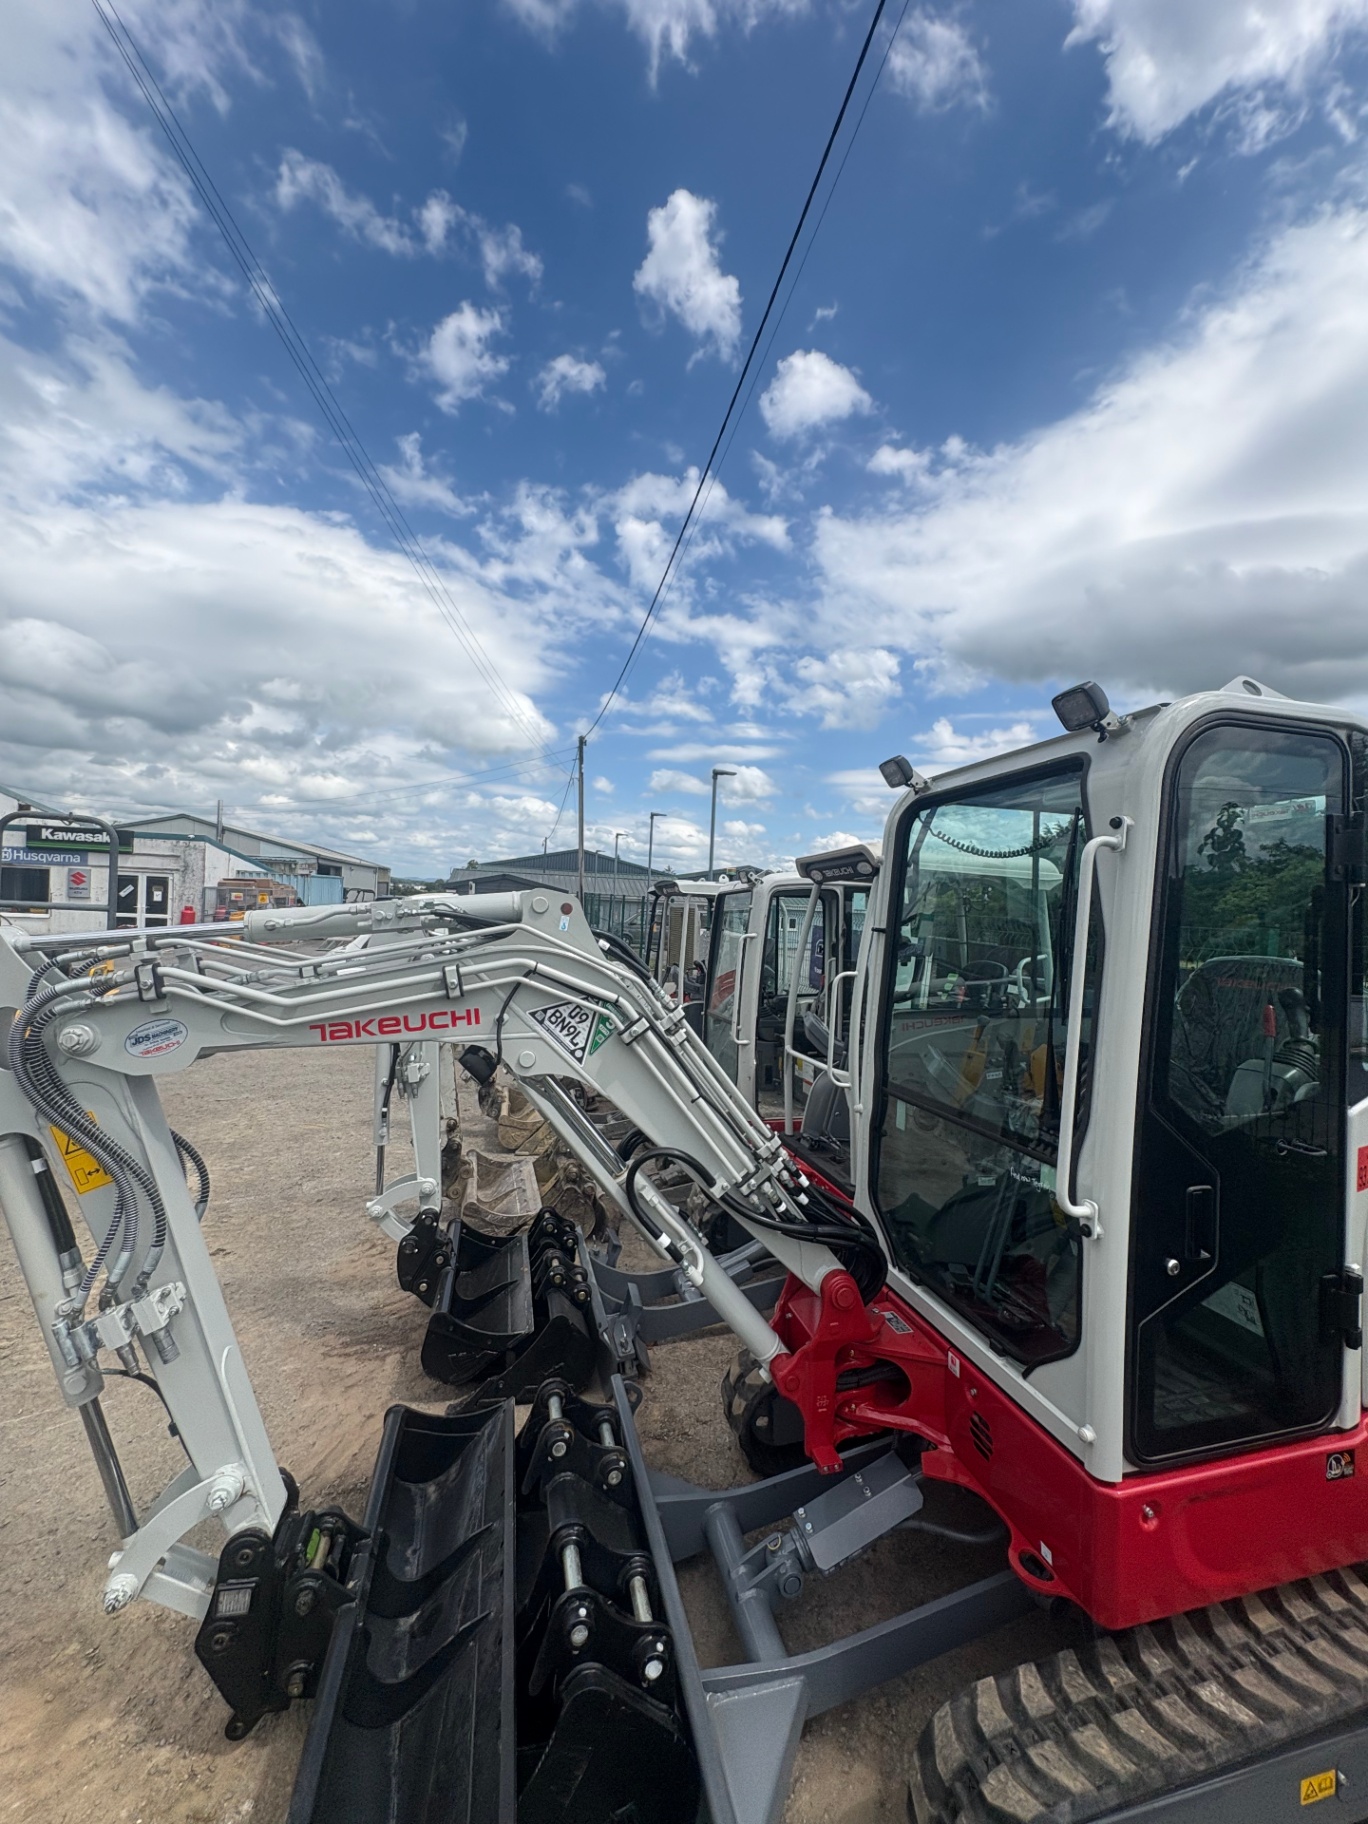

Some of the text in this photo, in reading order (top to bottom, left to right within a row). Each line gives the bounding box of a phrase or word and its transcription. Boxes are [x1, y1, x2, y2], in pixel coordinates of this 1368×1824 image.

[41, 828, 111, 843] Kawasak
[13, 849, 81, 863] Husqvarna
[309, 1008, 481, 1042] TAKEUCHI
[547, 1009, 580, 1047] BN9L
